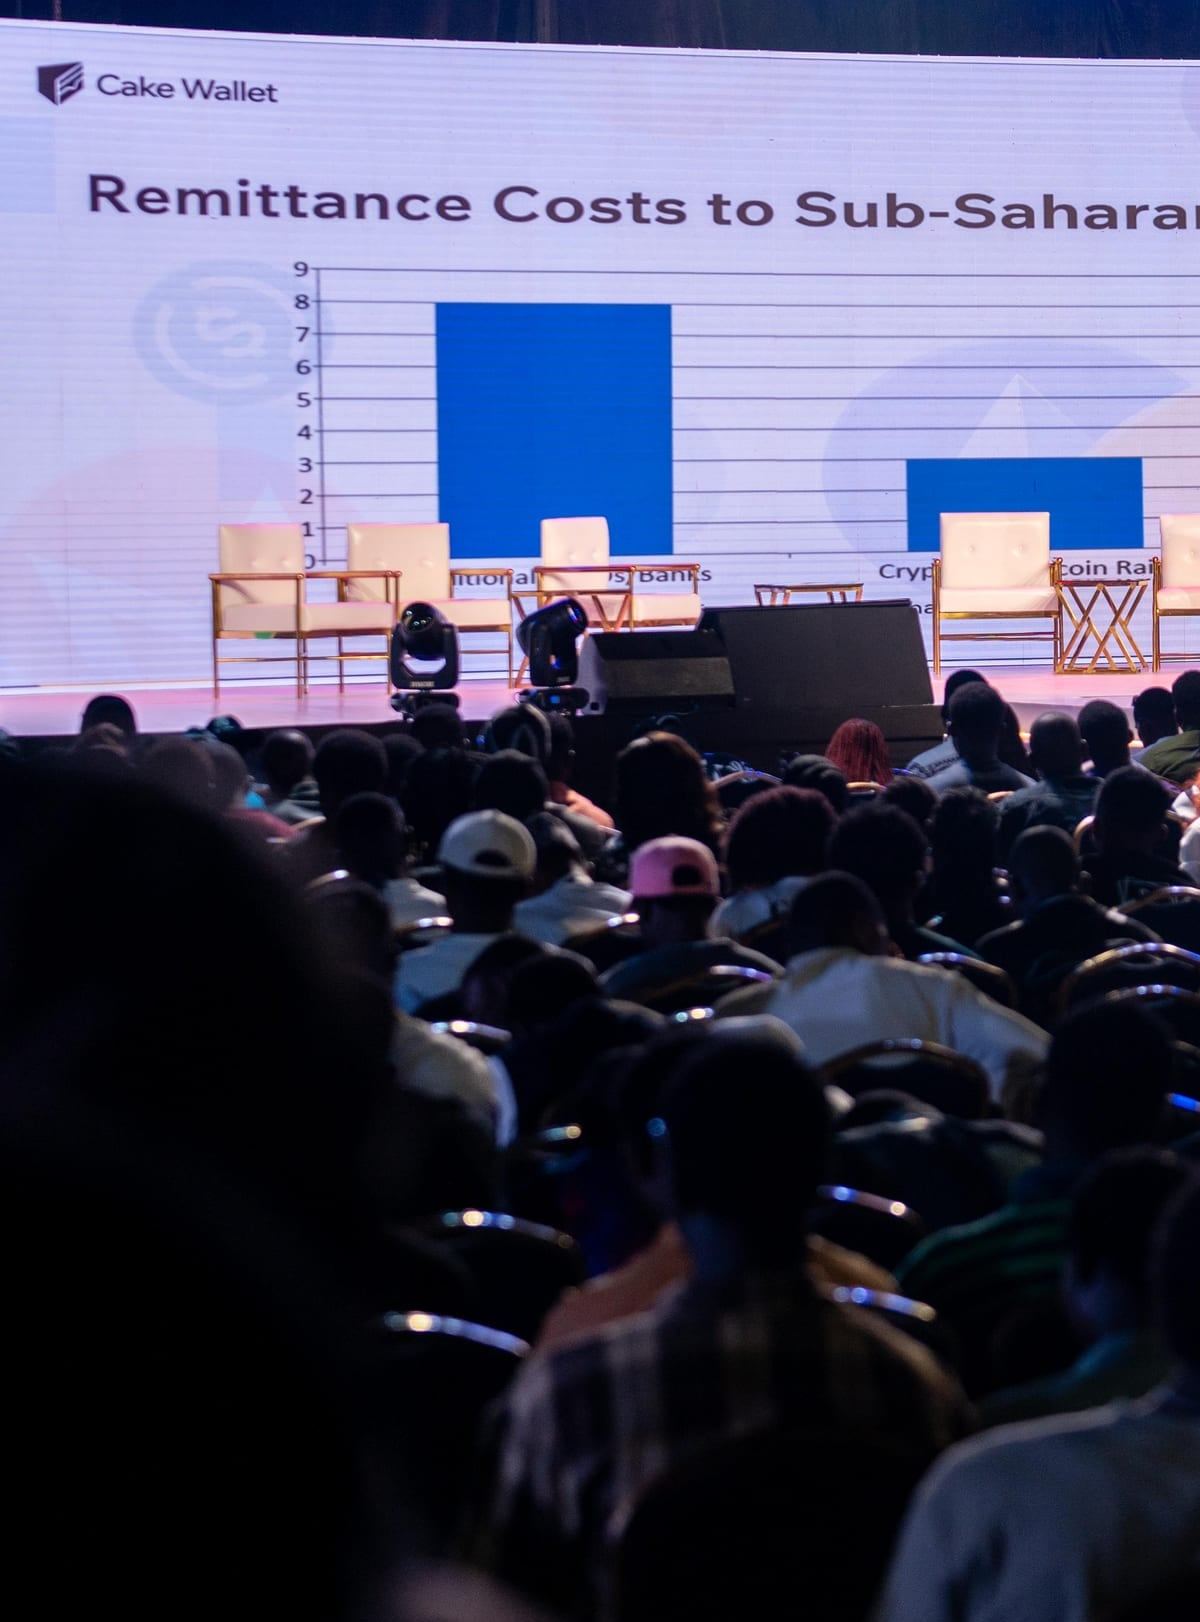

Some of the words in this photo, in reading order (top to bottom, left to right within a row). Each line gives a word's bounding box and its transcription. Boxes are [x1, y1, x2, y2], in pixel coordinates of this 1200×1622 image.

[97, 74, 175, 98] Cake
[181, 78, 279, 103] Wallet
[89, 174, 472, 221] Remittance
[493, 186, 687, 225] Costs
[706, 194, 774, 227] to
[294, 261, 309, 277] 9
[295, 294, 310, 310] 8
[296, 326, 310, 342] 7
[296, 359, 312, 375] 6
[297, 392, 312, 408] 5
[297, 424, 312, 440] 4
[298, 457, 313, 473] 3
[299, 489, 313, 505] 2
[302, 521, 315, 537] 1
[879, 564, 933, 582] Cryp
[1060, 560, 1108, 576] coin
[1117, 559, 1153, 575] Rai
